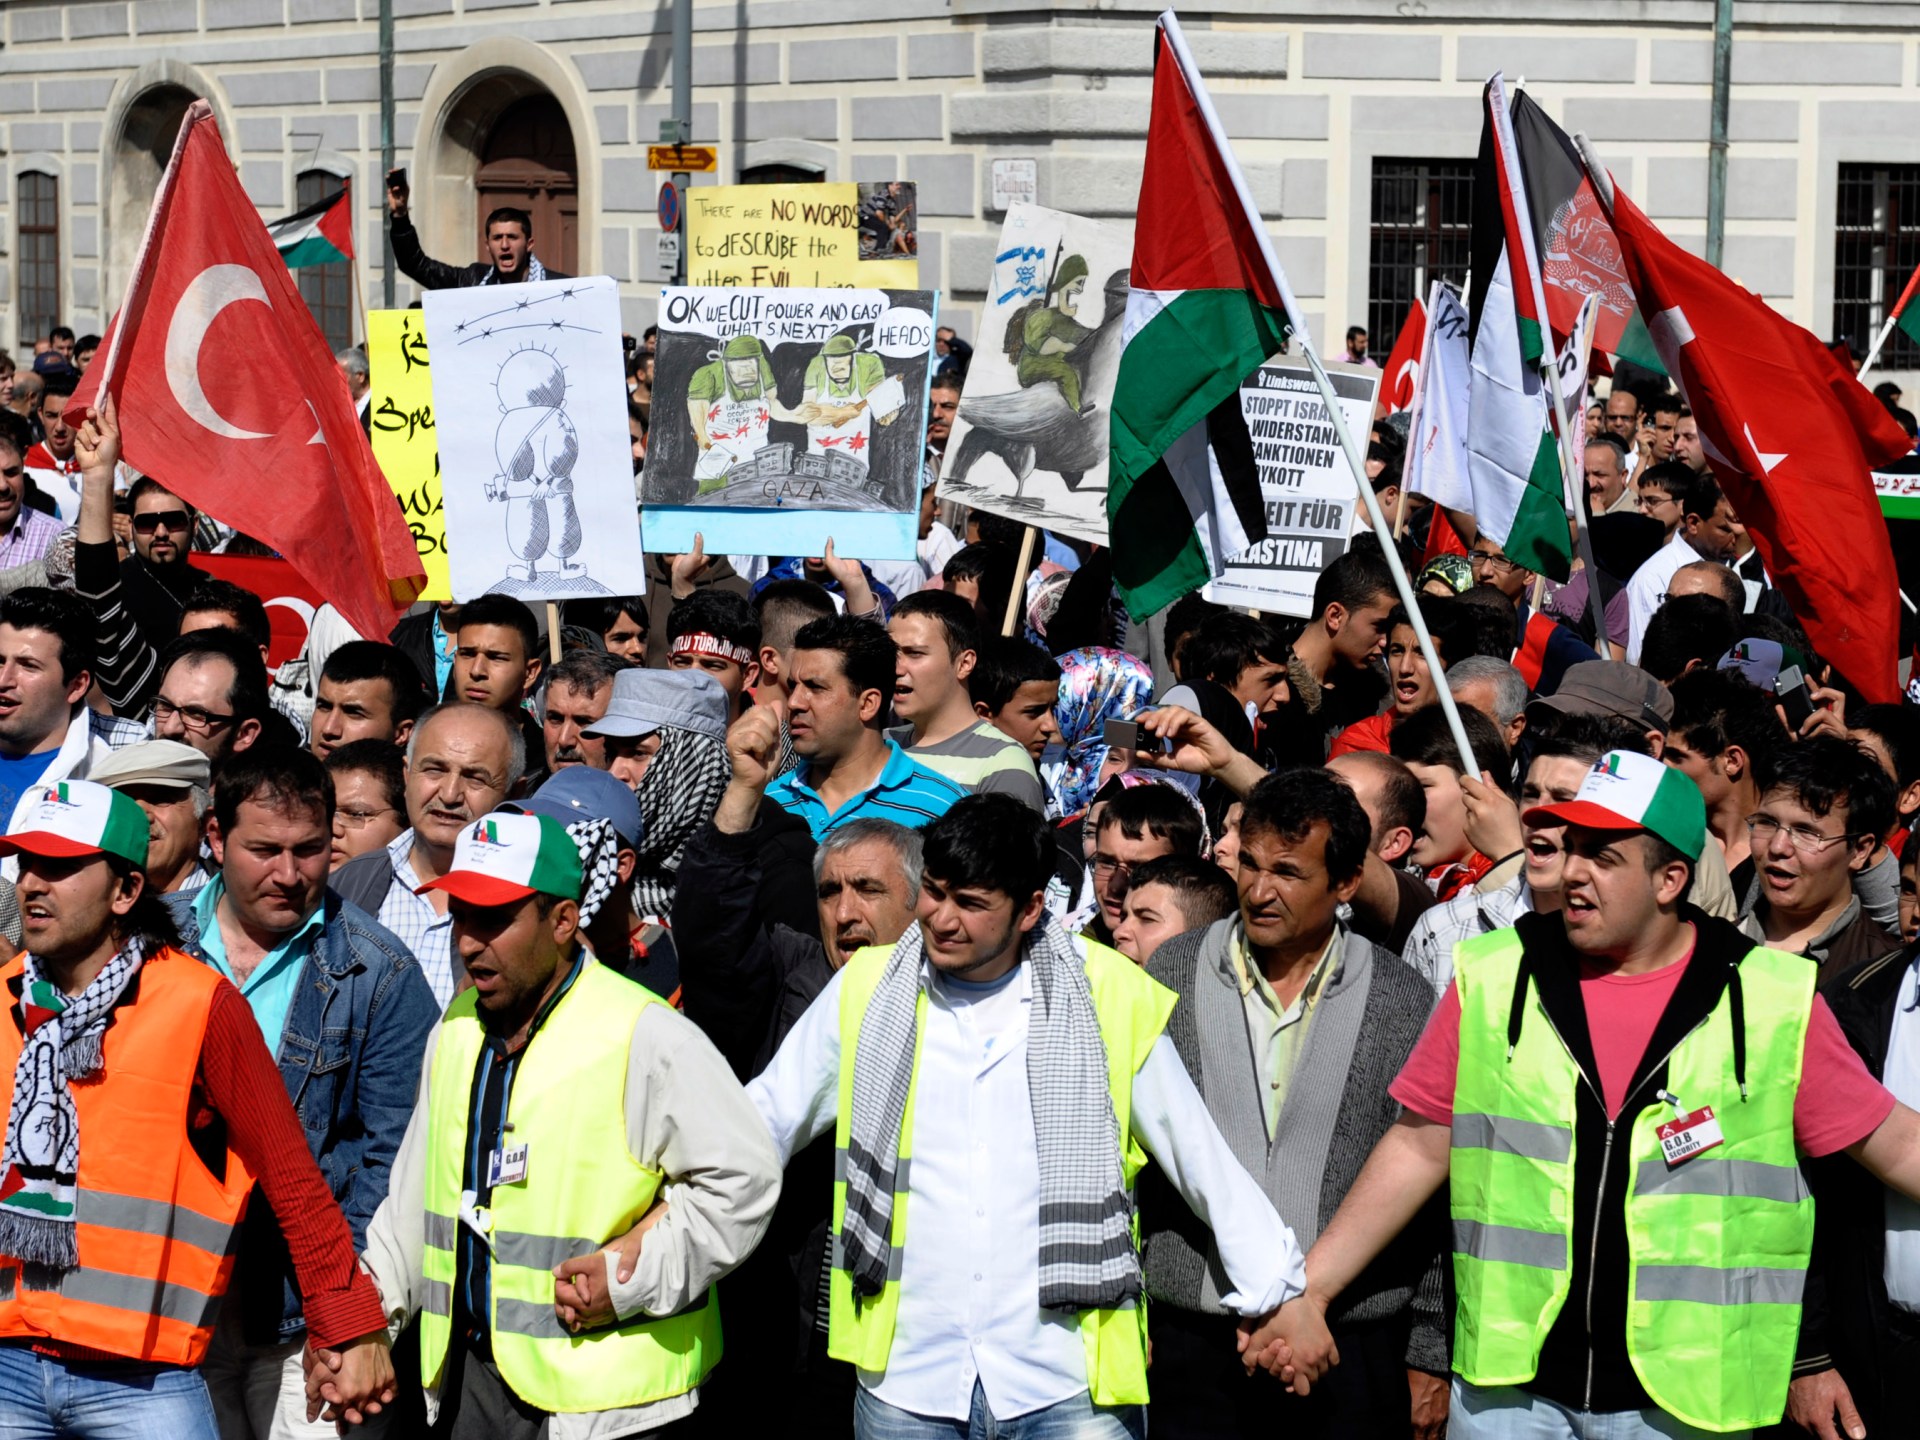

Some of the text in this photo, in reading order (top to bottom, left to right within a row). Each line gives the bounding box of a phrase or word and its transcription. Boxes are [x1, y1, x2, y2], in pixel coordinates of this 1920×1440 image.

[695, 198, 863, 229] THERE ARE NO WORDS
[695, 235, 715, 257] to
[807, 236, 838, 258] the
[667, 294, 705, 324] OK
[706, 305, 728, 322] WE
[729, 294, 764, 321] CUT
[766, 303, 814, 320] POWER
[820, 302, 848, 321] AND
[780, 322, 839, 340] NEXT?
[880, 325, 931, 347] HEADS
[1266, 374, 1321, 393] Linkswen
[1245, 396, 1292, 417] STOPPT
[1252, 419, 1343, 446] WIDERSTAND
[1252, 441, 1335, 469] ANKTIONEN
[762, 480, 826, 500] GAZA
[1298, 498, 1343, 530] FÜR
[1664, 1131, 1693, 1151] G.O.B
[1668, 1141, 1701, 1159] SECURITY
[506, 1151, 525, 1164] G.O.B
